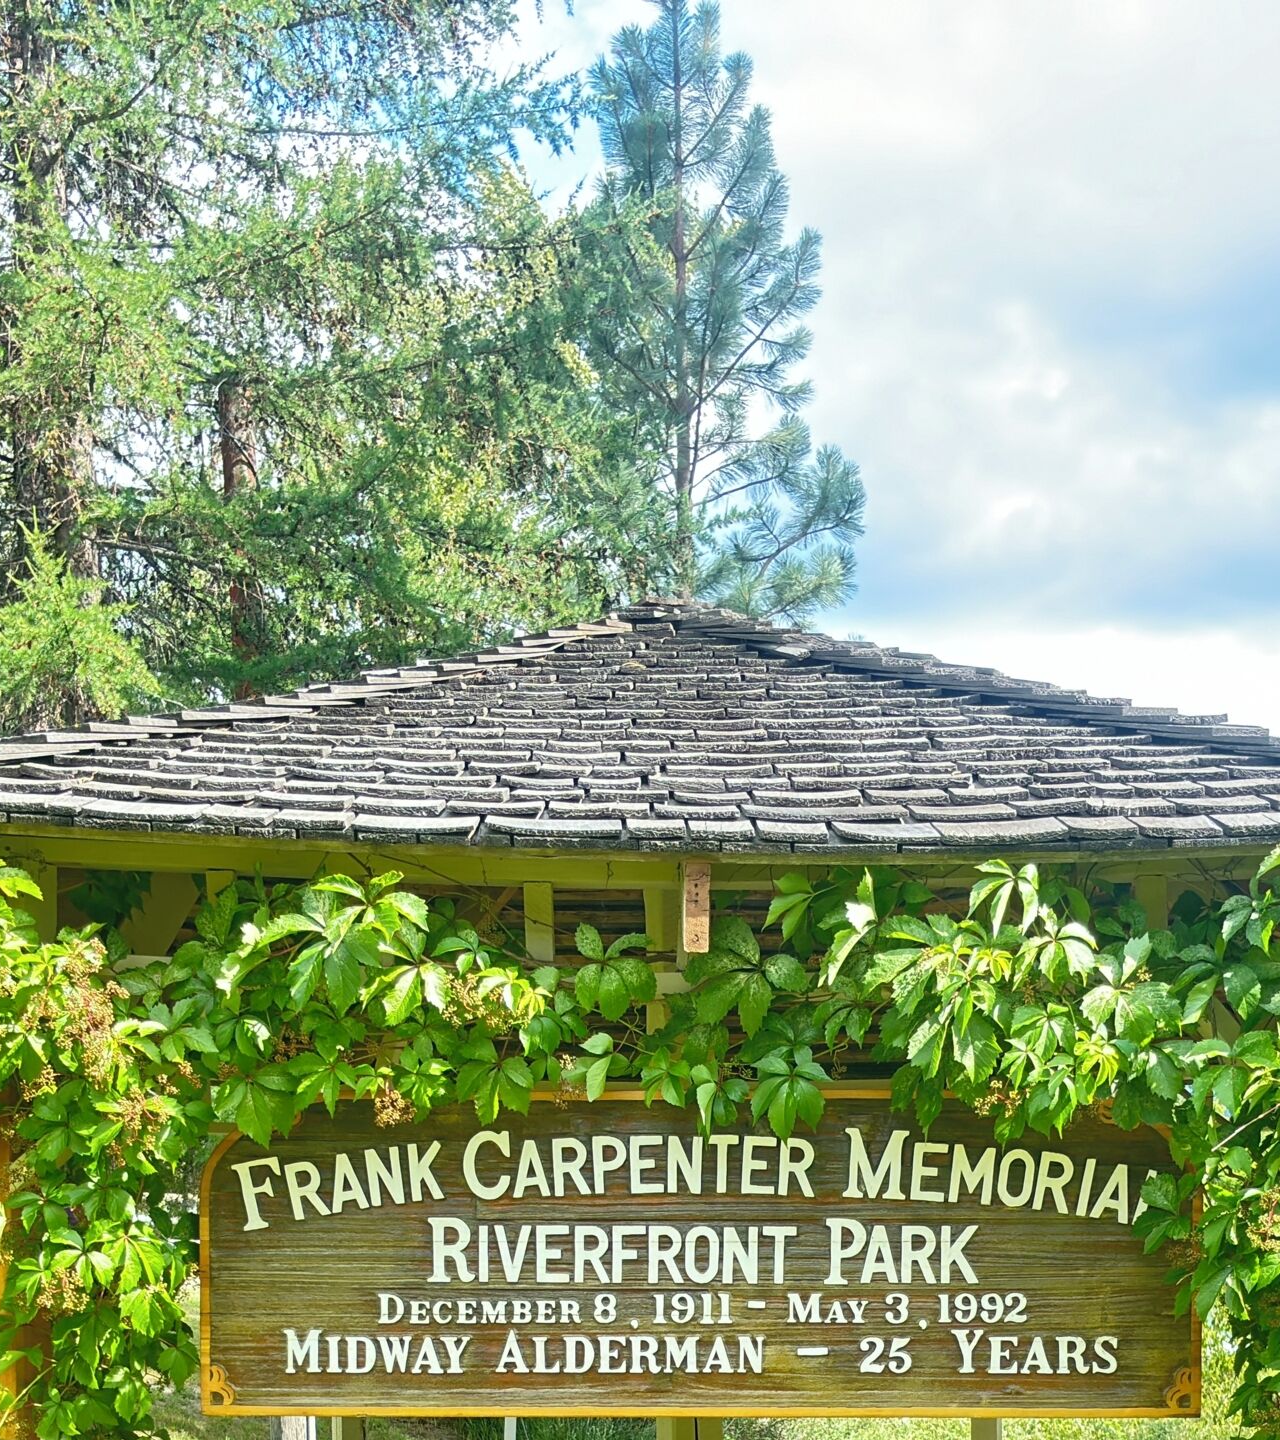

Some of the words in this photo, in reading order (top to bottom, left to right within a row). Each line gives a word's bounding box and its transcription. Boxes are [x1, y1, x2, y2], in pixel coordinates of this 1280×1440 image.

[231, 1140, 444, 1232] FRANK
[462, 1130, 815, 1200] CARPENTER
[426, 1216, 798, 1285] RIVERFRONT
[825, 1217, 979, 1285] PARK
[377, 1293, 583, 1324] DECEMBER
[652, 1293, 734, 1325] 1911
[786, 1293, 867, 1324] MAY
[937, 1292, 1028, 1324] 1992
[284, 1328, 471, 1374] MIDWAY
[495, 1328, 765, 1374] ALDERMAN
[859, 1336, 913, 1374] 25
[950, 1328, 1118, 1375] YEARS
